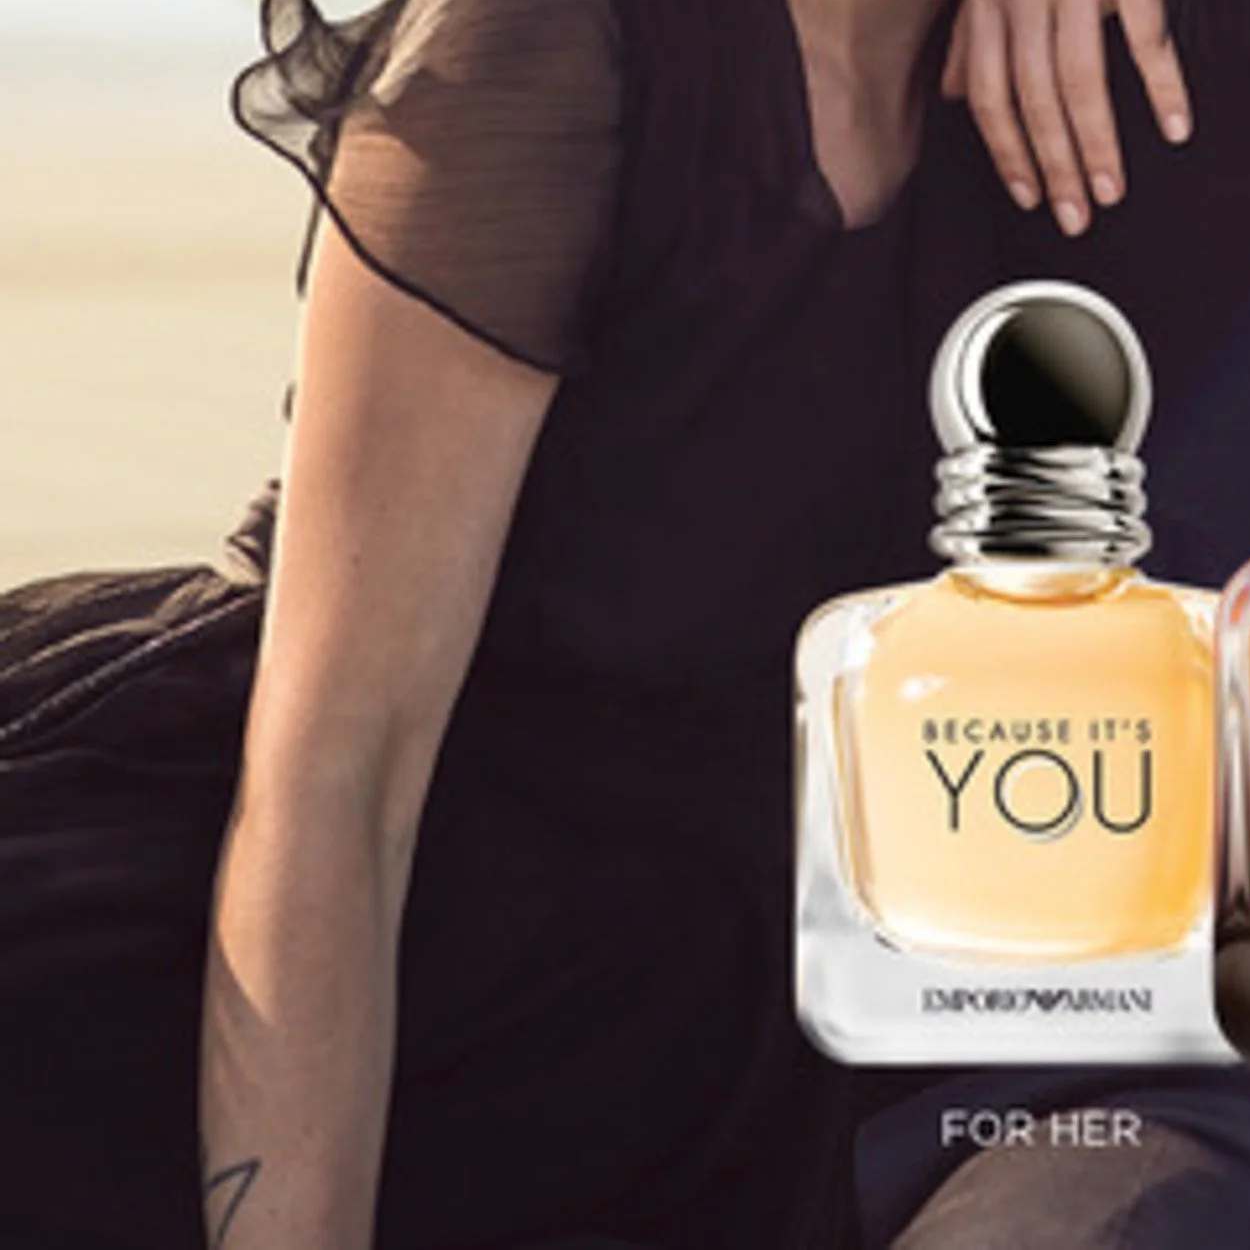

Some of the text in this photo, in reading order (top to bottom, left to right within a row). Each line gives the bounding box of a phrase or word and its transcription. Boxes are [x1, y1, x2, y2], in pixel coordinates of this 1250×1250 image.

[922, 719, 1153, 744] BECAUSE IT'S
[925, 749, 1153, 838] YOU
[941, 1110, 1142, 1148] FOR HER
